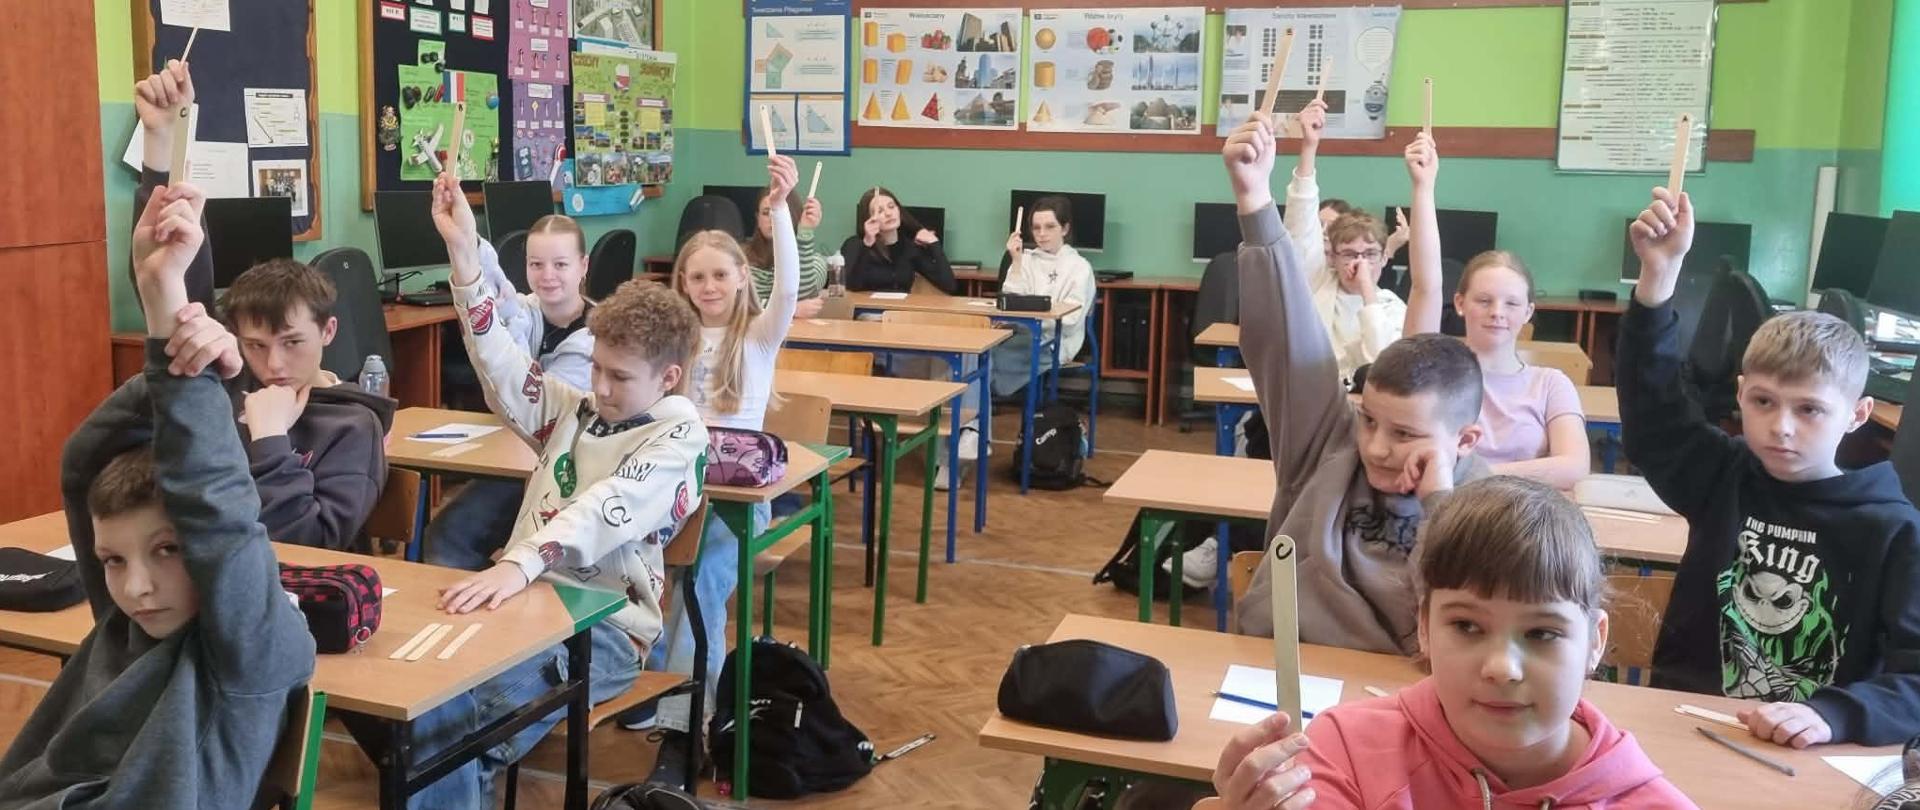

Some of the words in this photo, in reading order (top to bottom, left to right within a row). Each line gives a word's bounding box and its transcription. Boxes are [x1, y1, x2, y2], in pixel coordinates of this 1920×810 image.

[1035, 428, 1057, 445] Camp
[1276, 543, 1293, 560] C
[1738, 530, 1820, 583] King
